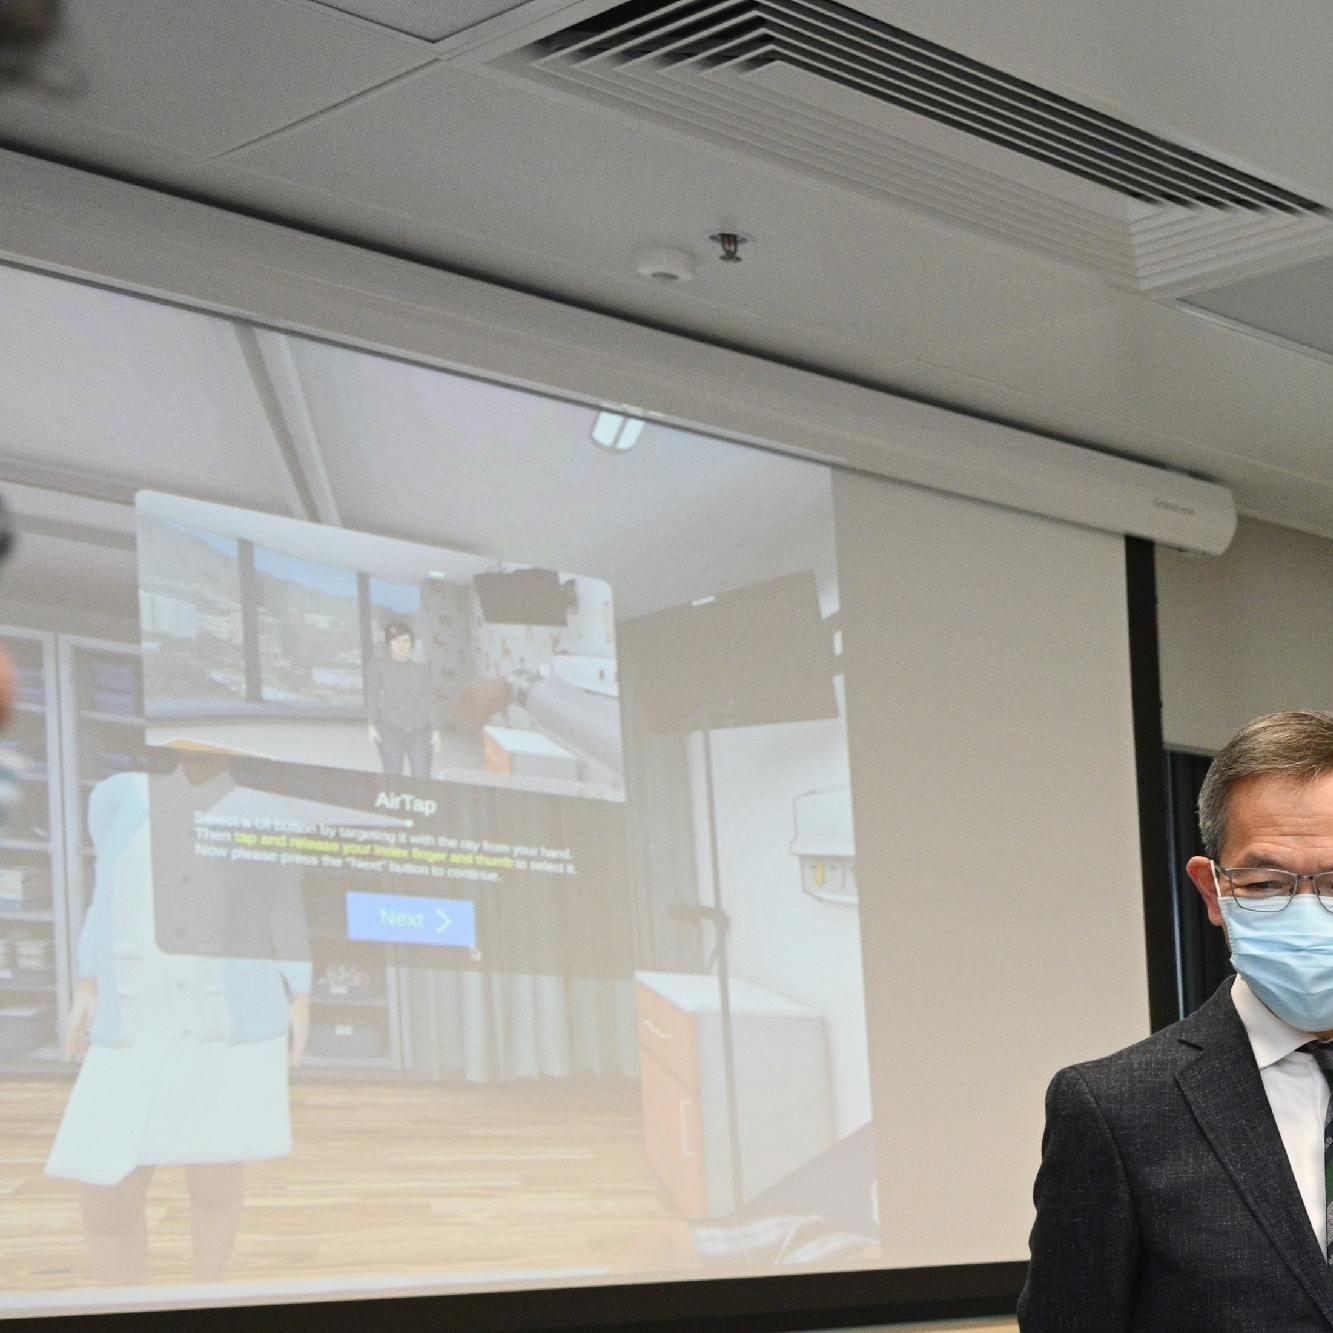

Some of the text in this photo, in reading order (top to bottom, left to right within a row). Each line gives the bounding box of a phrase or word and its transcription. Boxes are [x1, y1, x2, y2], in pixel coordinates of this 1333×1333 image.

[375, 791, 437, 816] AirTap
[195, 827, 232, 841] Then
[233, 831, 257, 846] tap
[259, 834, 287, 848] and
[289, 837, 340, 852] release
[342, 842, 371, 856] your
[373, 844, 408, 858] index
[411, 848, 448, 864] finger
[450, 852, 474, 864] and
[475, 854, 514, 868] thumb
[515, 858, 528, 870] to
[530, 860, 564, 874] select
[273, 818, 317, 834] button
[319, 823, 337, 839] by
[339, 826, 396, 844] targeting
[409, 834, 435, 846] with
[437, 836, 458, 849] the
[482, 840, 511, 854] from
[513, 845, 538, 858] your
[195, 844, 229, 857] Now
[231, 849, 277, 862] please
[279, 852, 319, 866] press
[321, 855, 343, 867] the
[388, 861, 429, 875] button
[431, 865, 445, 877] to
[381, 908, 425, 929] Next
